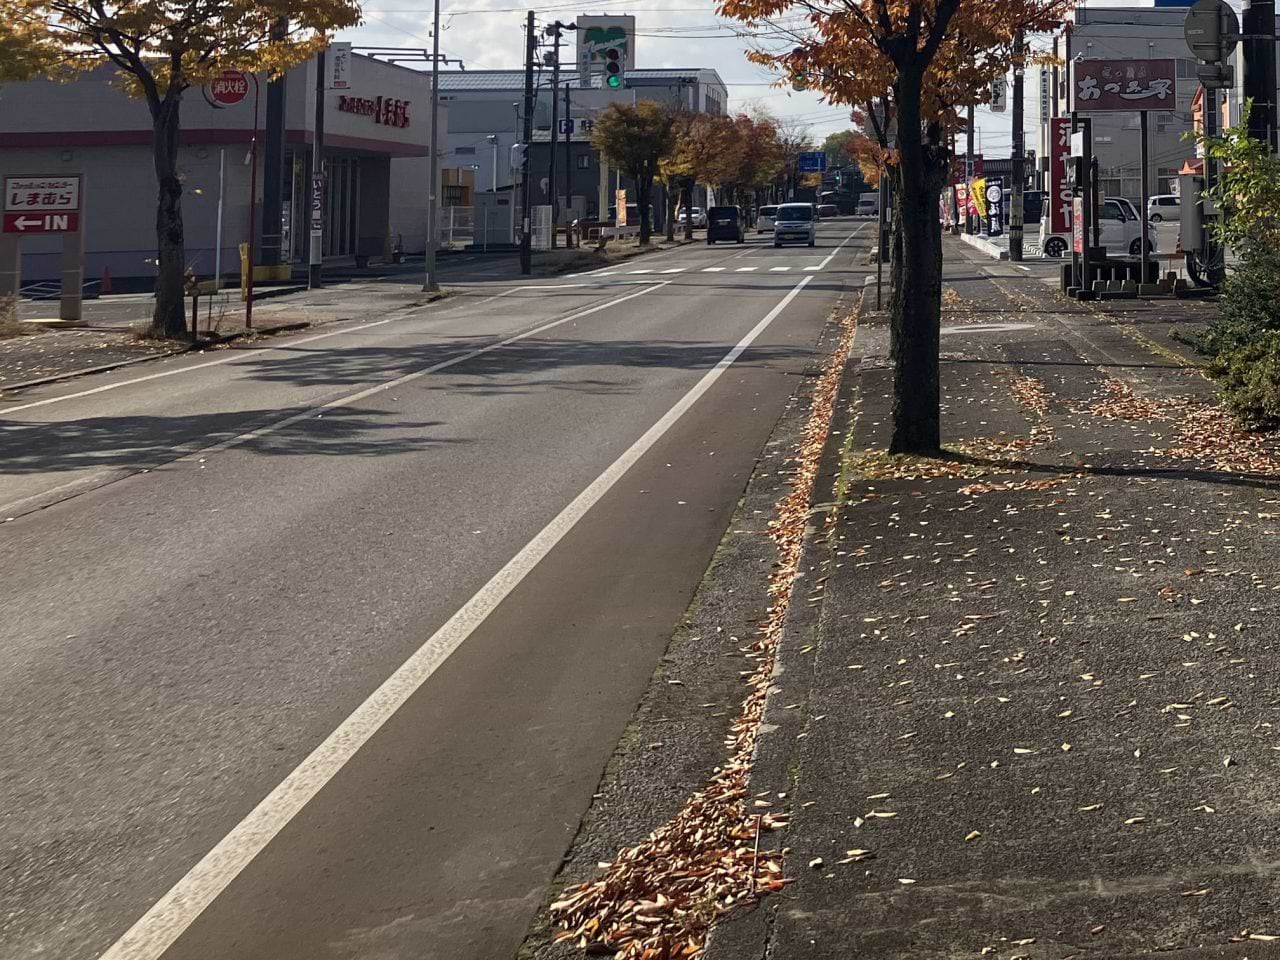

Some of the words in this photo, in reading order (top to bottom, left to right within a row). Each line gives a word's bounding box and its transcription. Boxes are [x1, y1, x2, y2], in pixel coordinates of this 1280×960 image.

[214, 80, 246, 94] 消火栓
[11, 191, 73, 206] しまむら
[44, 215, 68, 230] IN
